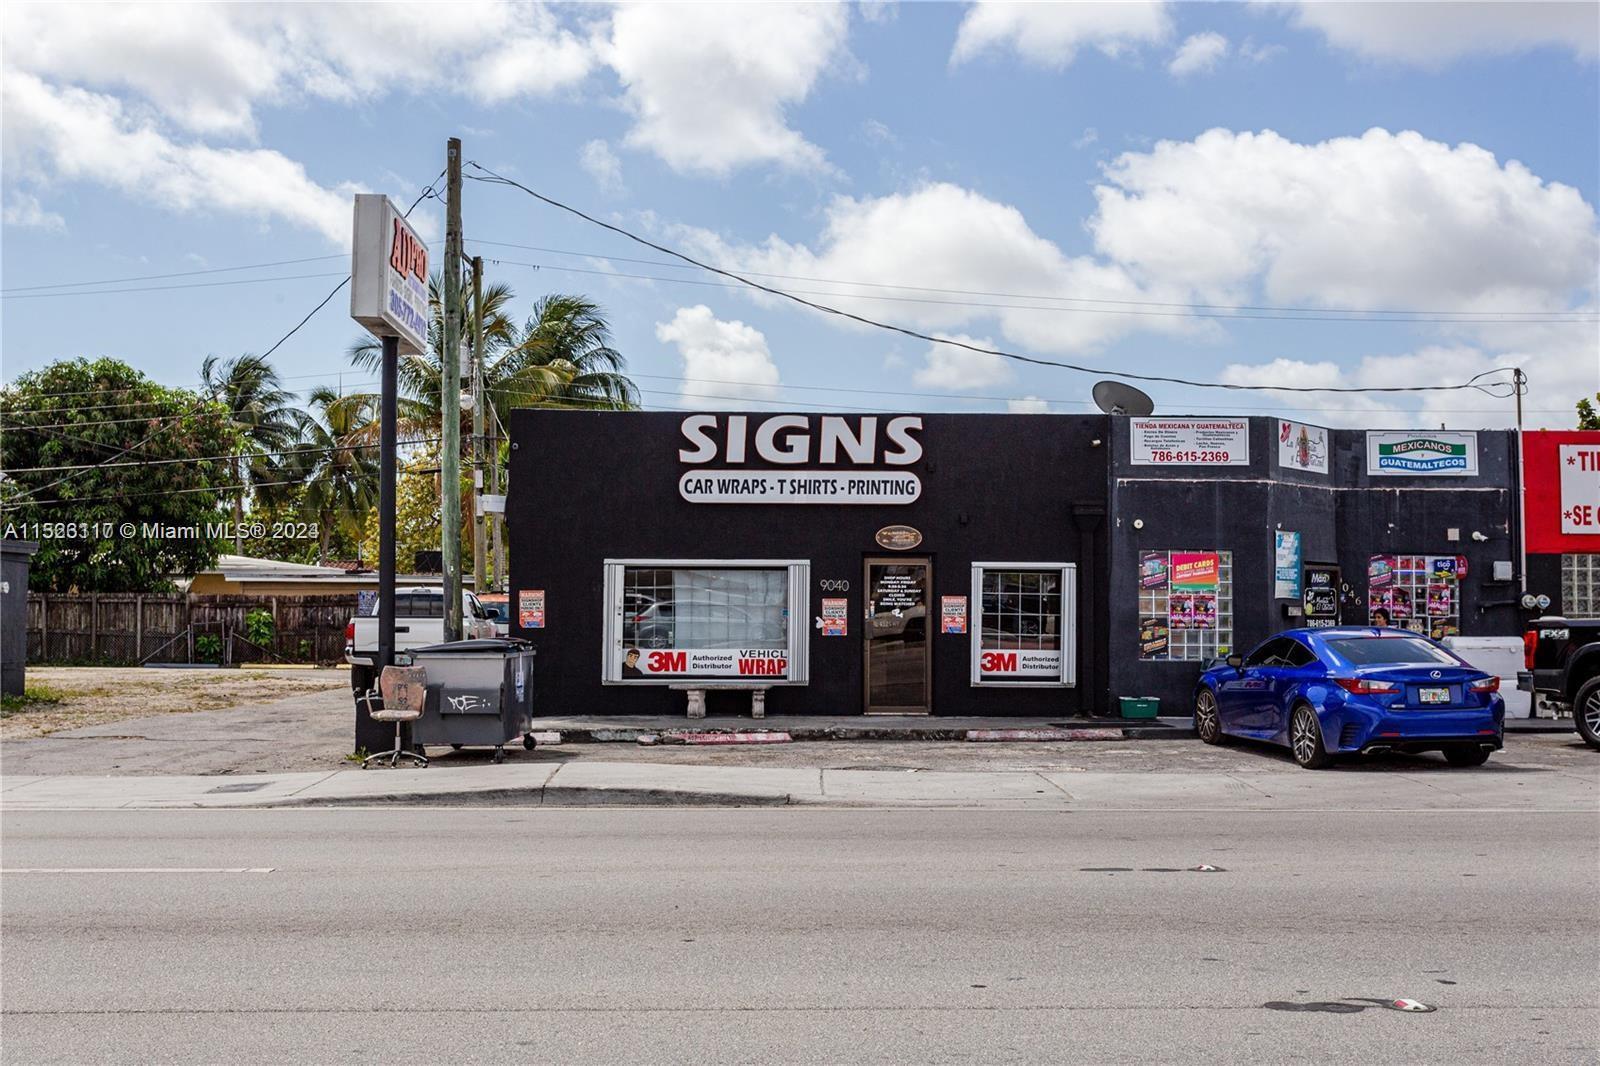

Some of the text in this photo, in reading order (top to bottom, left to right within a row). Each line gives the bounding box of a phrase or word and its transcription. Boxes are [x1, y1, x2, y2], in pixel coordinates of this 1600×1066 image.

[678, 414, 923, 465] SIGNS
[1392, 440, 1453, 453] MEXICANOS
[1151, 451, 1230, 462] 786-615-2369
[1380, 458, 1465, 469] GUATEMALTECOS
[684, 478, 713, 495] CAR
[717, 478, 767, 495] WRAPS
[777, 479, 787, 495] T
[790, 479, 837, 495] SHIRTS
[848, 479, 915, 496] PRINTING
[1194, 559, 1215, 569] CARDS
[820, 579, 850, 591] 9040
[1540, 629, 1569, 640] FX4
[647, 652, 687, 673] 3M
[738, 659, 788, 675] WRAP
[980, 652, 1017, 672] 3M
